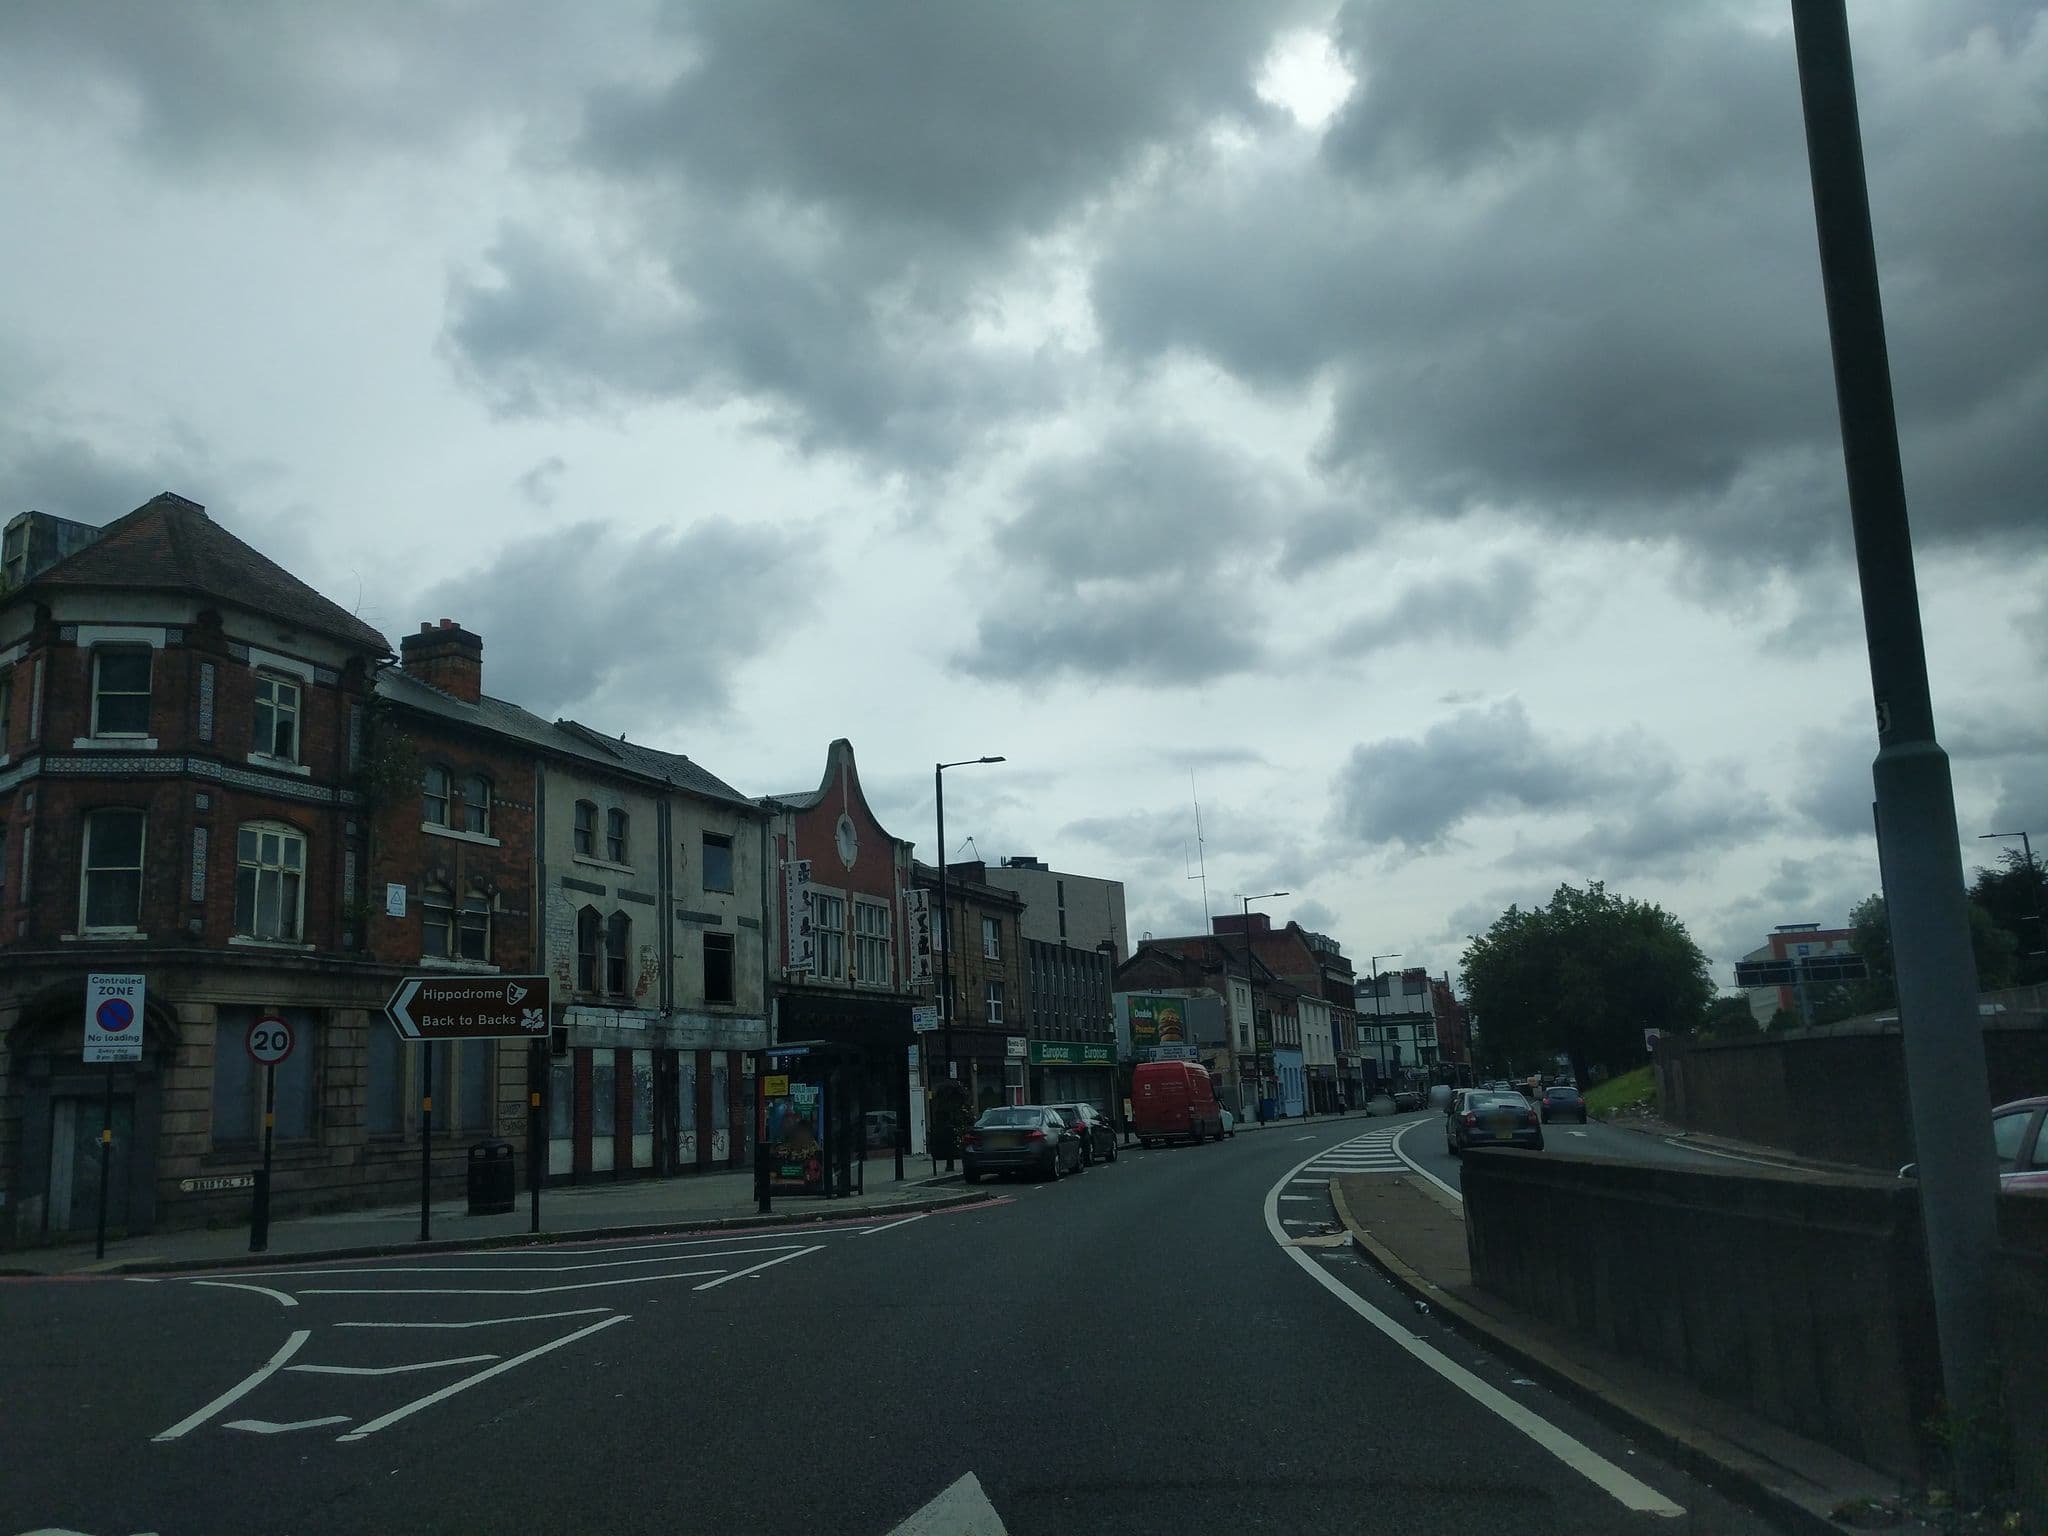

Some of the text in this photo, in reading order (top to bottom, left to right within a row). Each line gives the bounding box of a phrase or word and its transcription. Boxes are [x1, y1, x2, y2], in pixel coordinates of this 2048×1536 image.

[92, 976, 143, 985] Controlled
[99, 986, 135, 996] ZONE
[422, 988, 504, 1002] Hippodrome
[422, 1013, 517, 1027] Back to Backs
[88, 1034, 141, 1043] No loading
[253, 1030, 289, 1051] 20
[1042, 1043, 1070, 1060] Europcar
[1084, 1045, 1108, 1060] Europcar
[193, 1179, 234, 1190] BRISTOL
